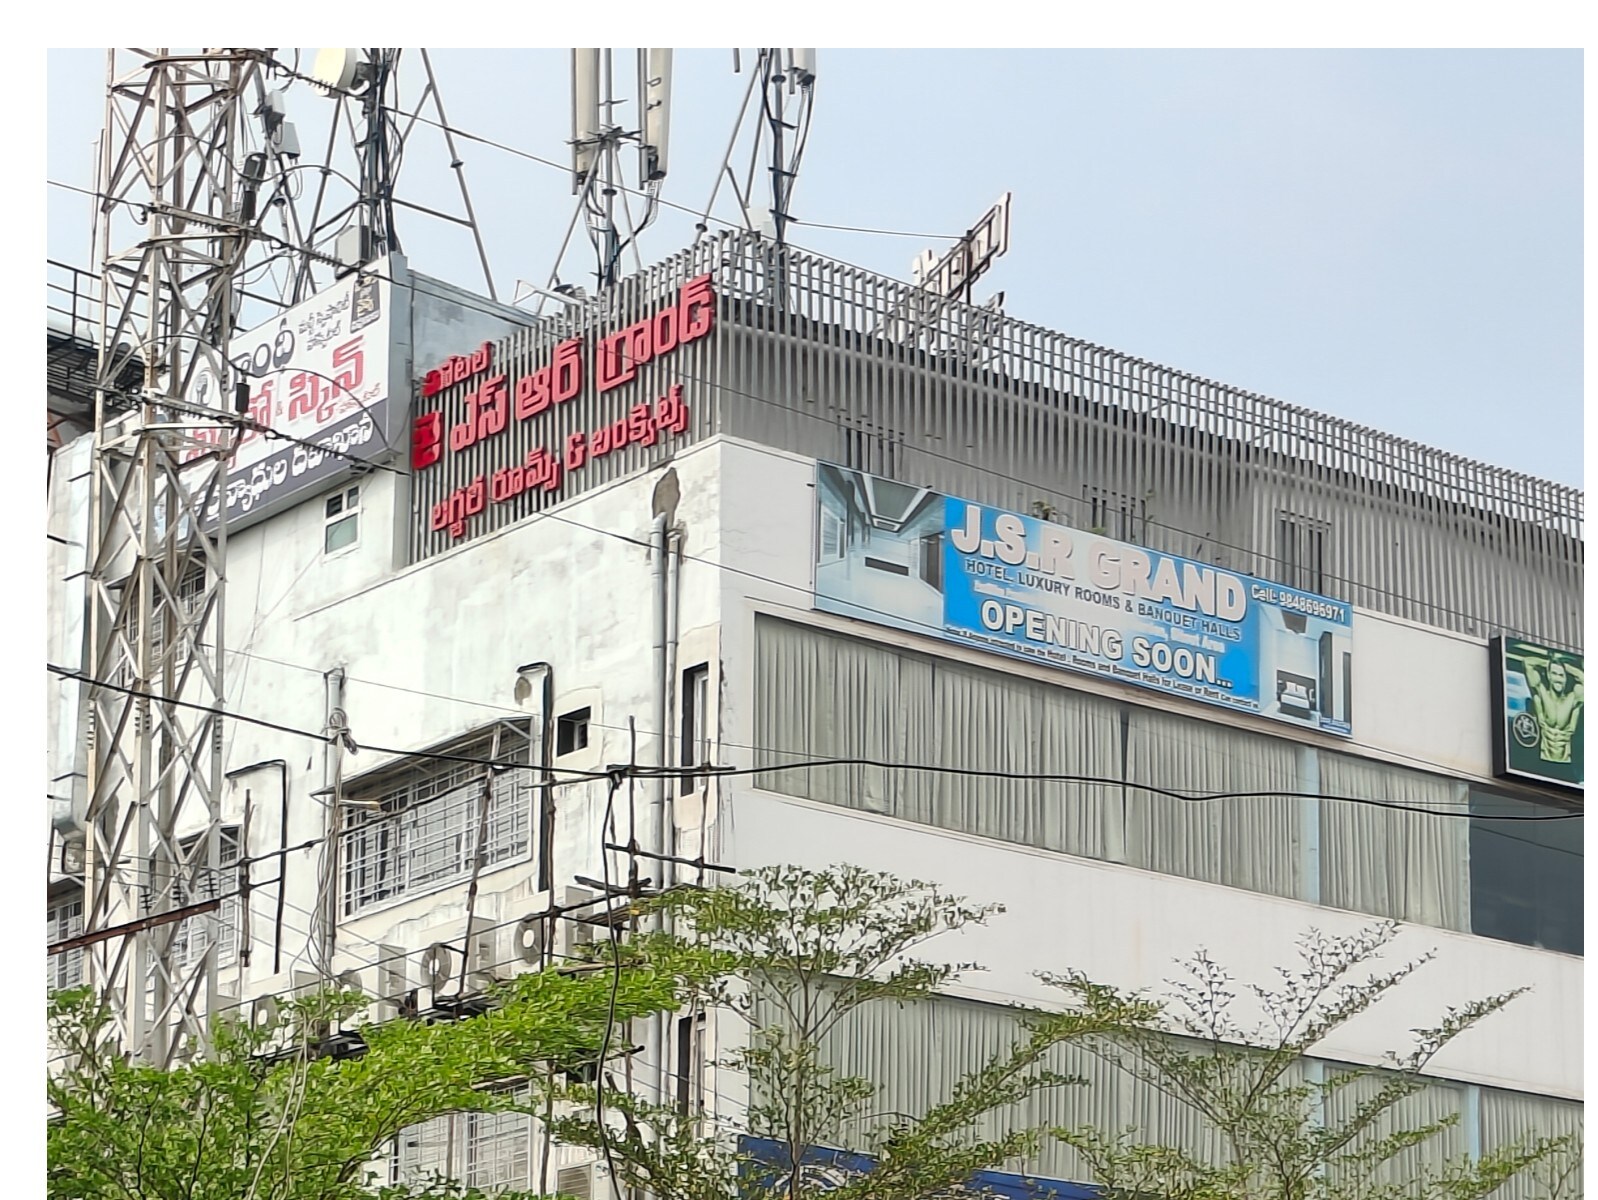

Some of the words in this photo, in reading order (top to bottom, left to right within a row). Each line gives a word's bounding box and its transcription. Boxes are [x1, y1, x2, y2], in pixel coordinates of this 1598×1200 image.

[515, 336, 584, 420] ఆర్
[951, 505, 1075, 580] J.S.R
[1088, 542, 1247, 623] GRAND
[1018, 571, 1070, 597] LUXURY
[1075, 586, 1120, 611] ROOMS
[1138, 604, 1197, 629] BANQUET
[981, 600, 1123, 662] OPENING
